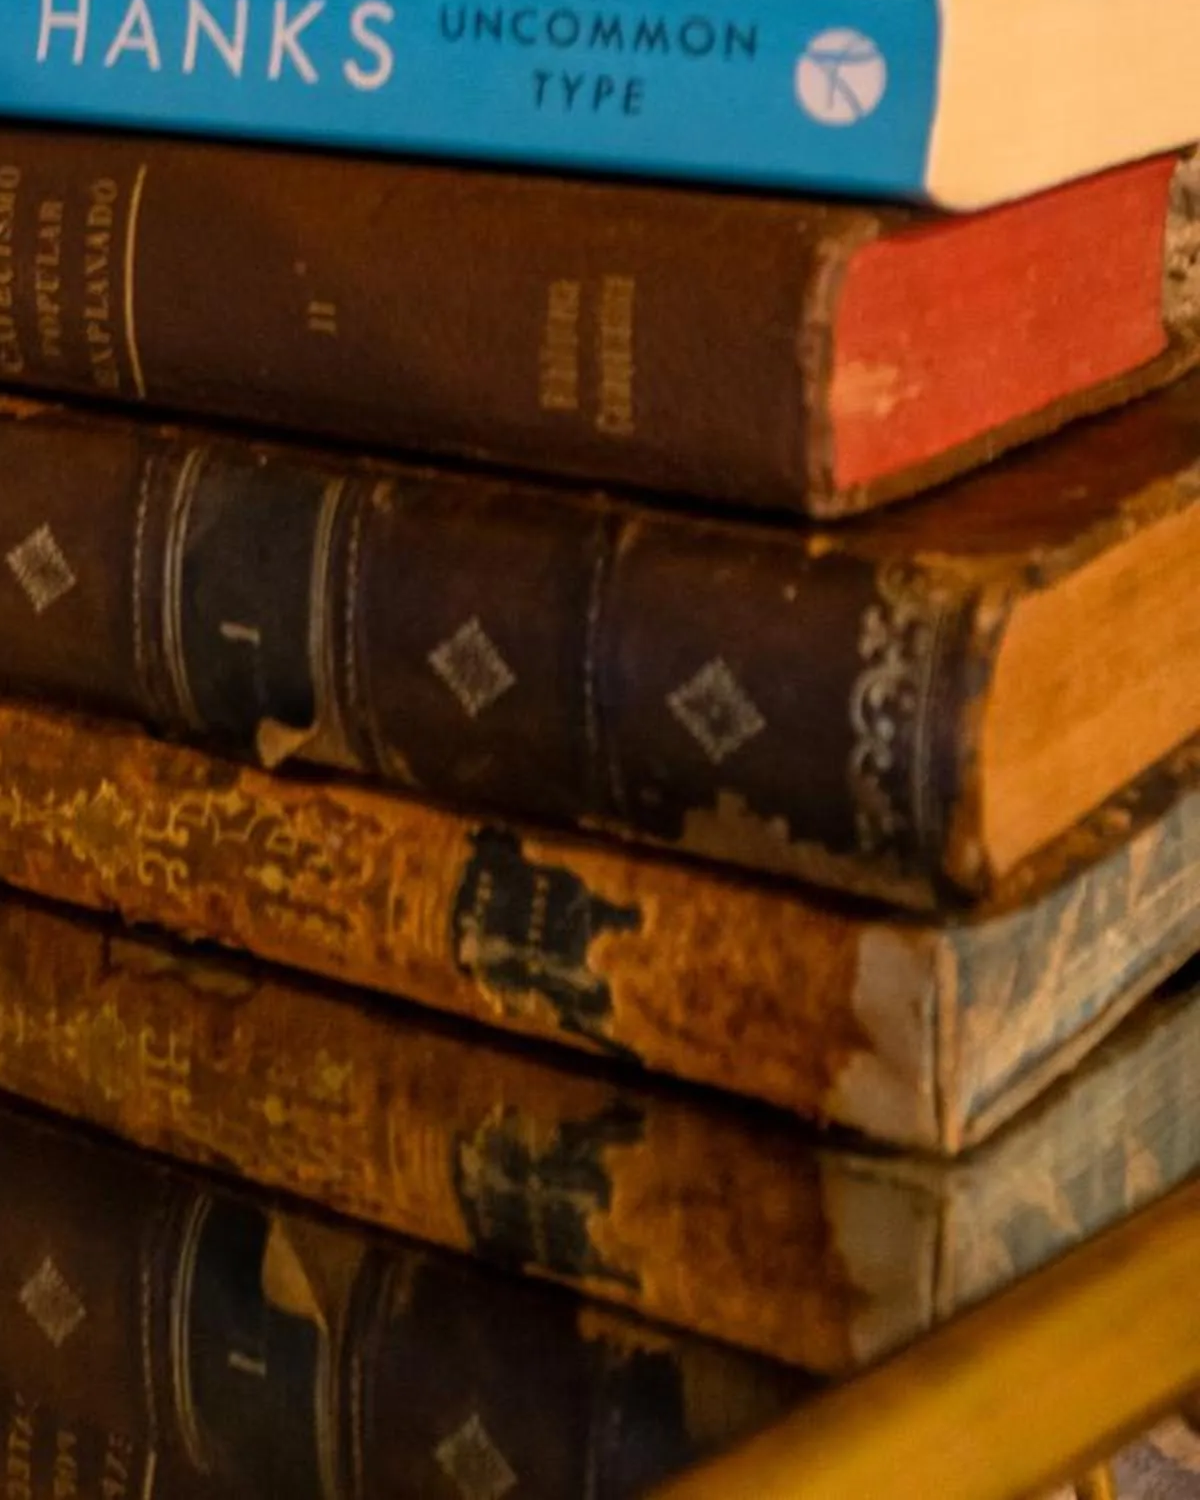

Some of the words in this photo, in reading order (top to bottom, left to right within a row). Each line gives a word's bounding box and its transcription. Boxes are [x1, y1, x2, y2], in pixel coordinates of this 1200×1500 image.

[438, 3, 761, 59] UNCOMMON
[531, 68, 645, 118] TYPE
[34, 200, 64, 358] POPULAR
